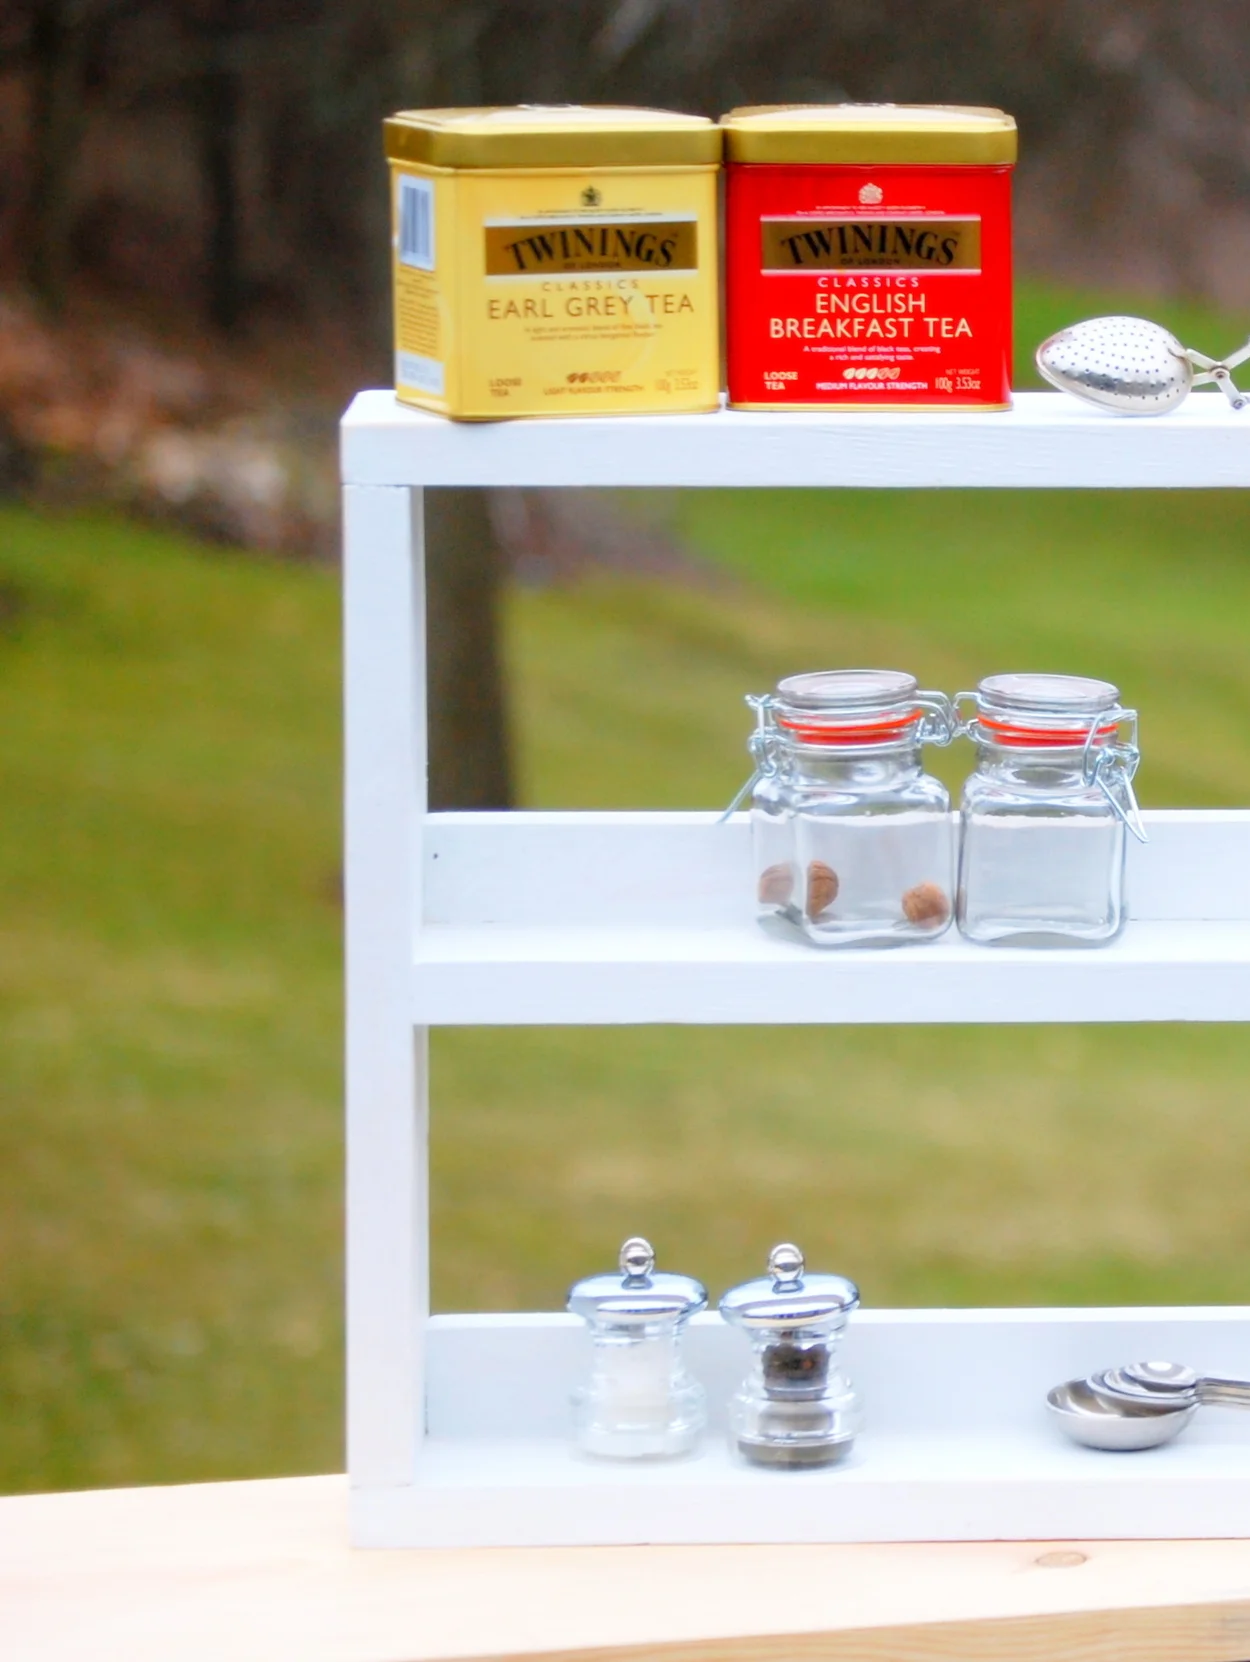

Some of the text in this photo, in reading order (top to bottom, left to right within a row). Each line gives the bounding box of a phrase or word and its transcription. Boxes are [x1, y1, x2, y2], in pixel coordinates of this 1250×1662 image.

[505, 227, 676, 270] TWININGS
[780, 224, 959, 266] TWININGS
[541, 279, 640, 292] CLASSICS
[817, 277, 920, 288] CLASSICS
[487, 294, 695, 320] EARL GREY TEA
[815, 293, 926, 314] ENGLISH
[769, 317, 973, 339] BREAKFAST TEA
[763, 371, 798, 381] LOOSE
[765, 381, 785, 390] TEA
[815, 382, 928, 390] MEDIUM FLAVOUR STRENGTH
